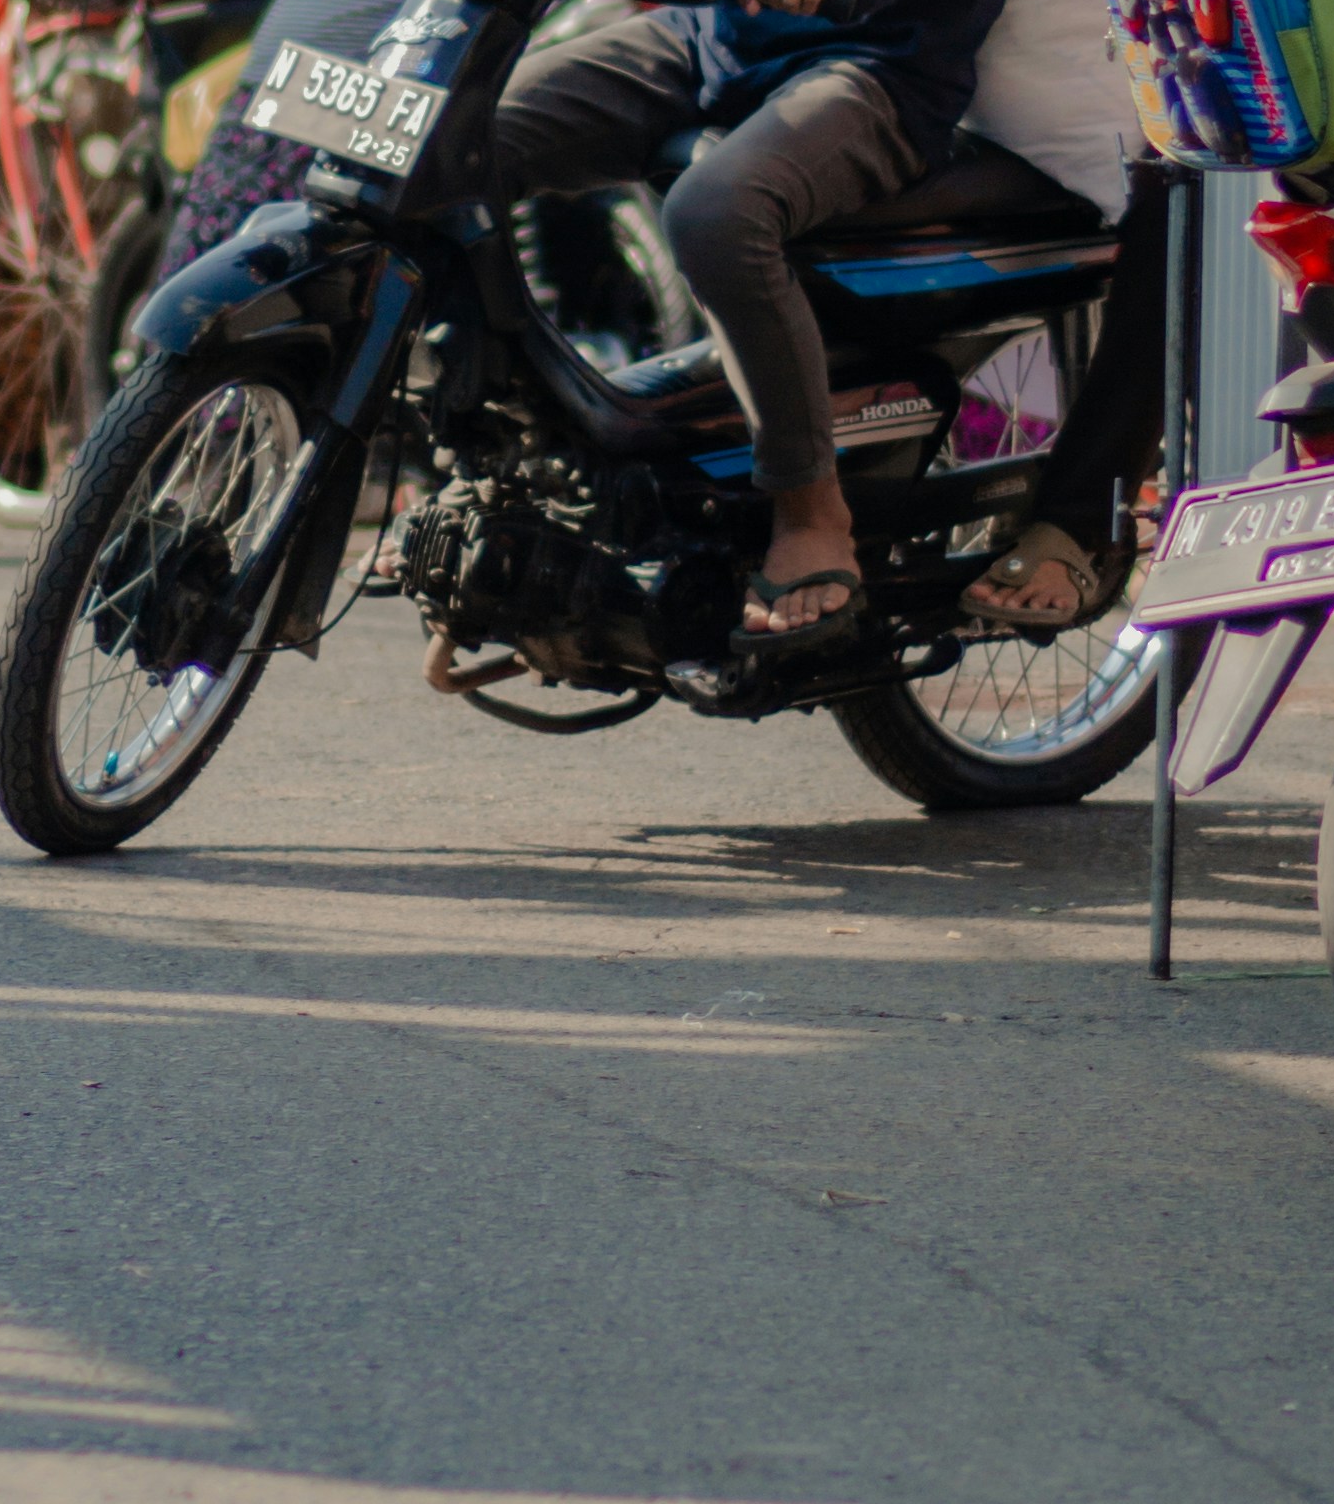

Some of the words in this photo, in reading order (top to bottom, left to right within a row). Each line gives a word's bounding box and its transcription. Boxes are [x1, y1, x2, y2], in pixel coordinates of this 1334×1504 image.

[266, 48, 297, 90] N
[303, 59, 384, 119] 5365
[387, 89, 431, 136] FA
[861, 397, 933, 421] HONDA
[1177, 512, 1206, 558] N
[1221, 495, 1307, 547] 4919
